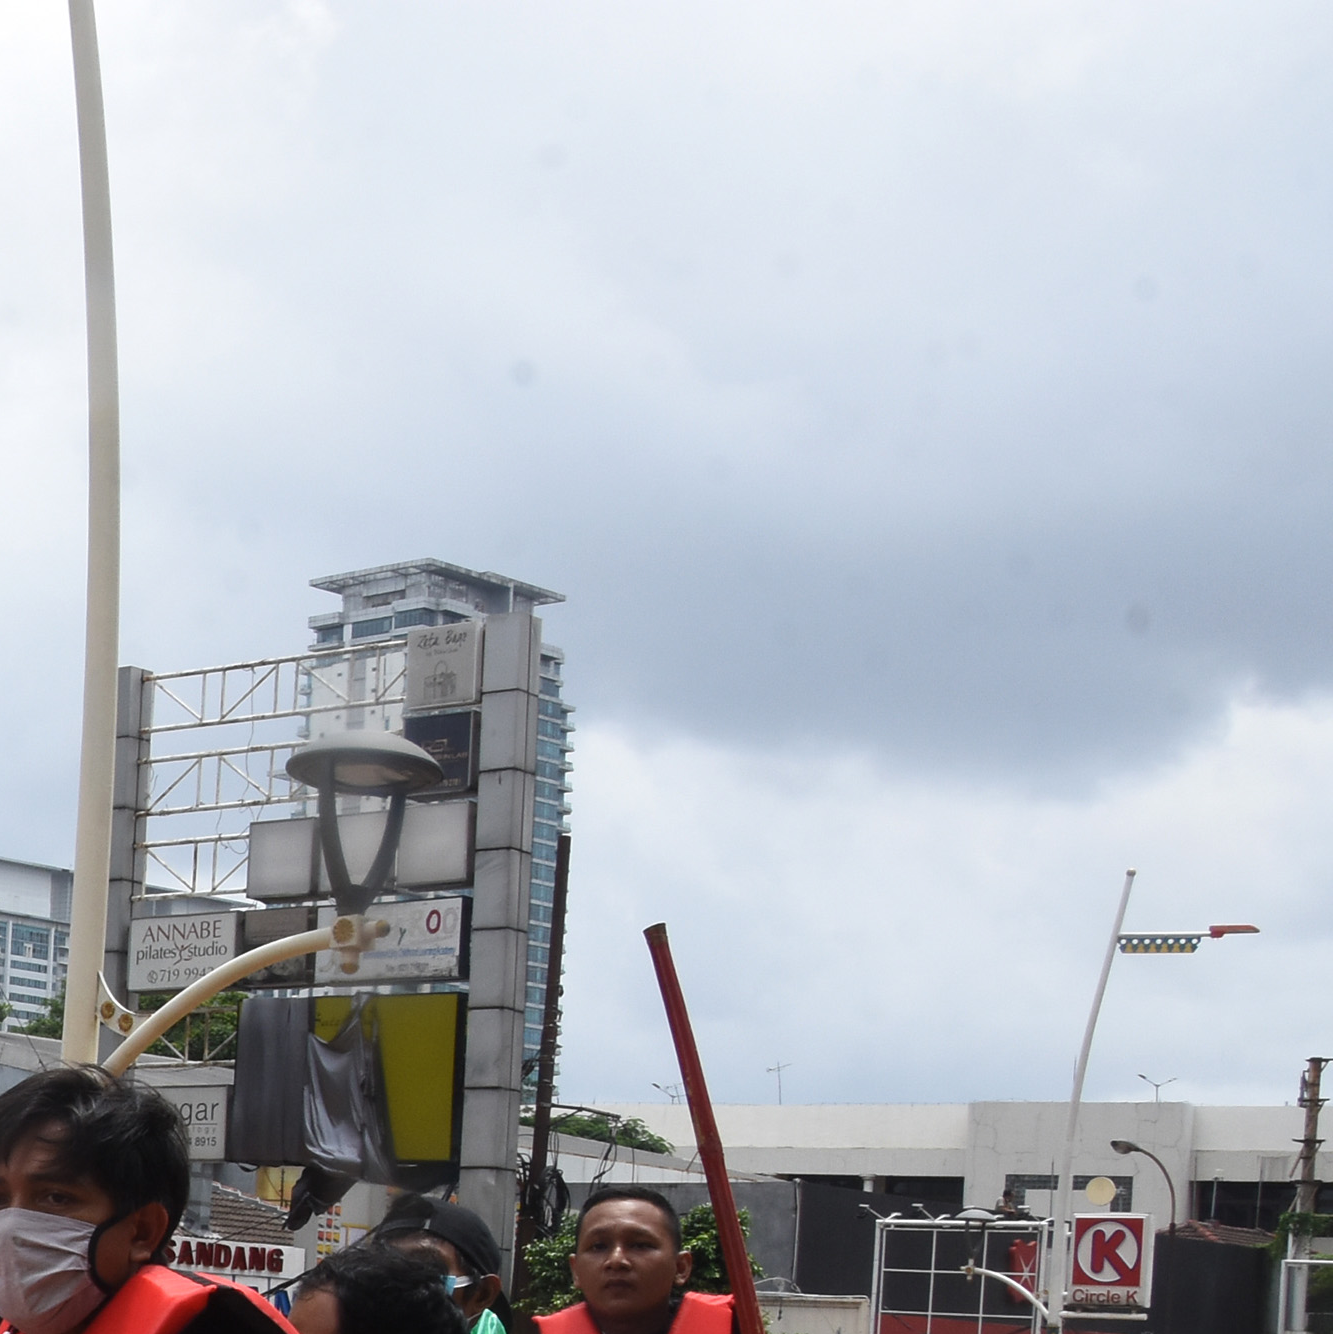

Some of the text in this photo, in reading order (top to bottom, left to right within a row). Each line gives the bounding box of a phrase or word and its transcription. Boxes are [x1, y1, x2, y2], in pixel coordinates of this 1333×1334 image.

[142, 920, 223, 943] ANNABE
[136, 940, 228, 965] pilates studio
[159, 968, 180, 982] 719
[194, 1136, 217, 1147] 8915
[1090, 1228, 1135, 1279] K
[1072, 1287, 1138, 1305] Circle K
